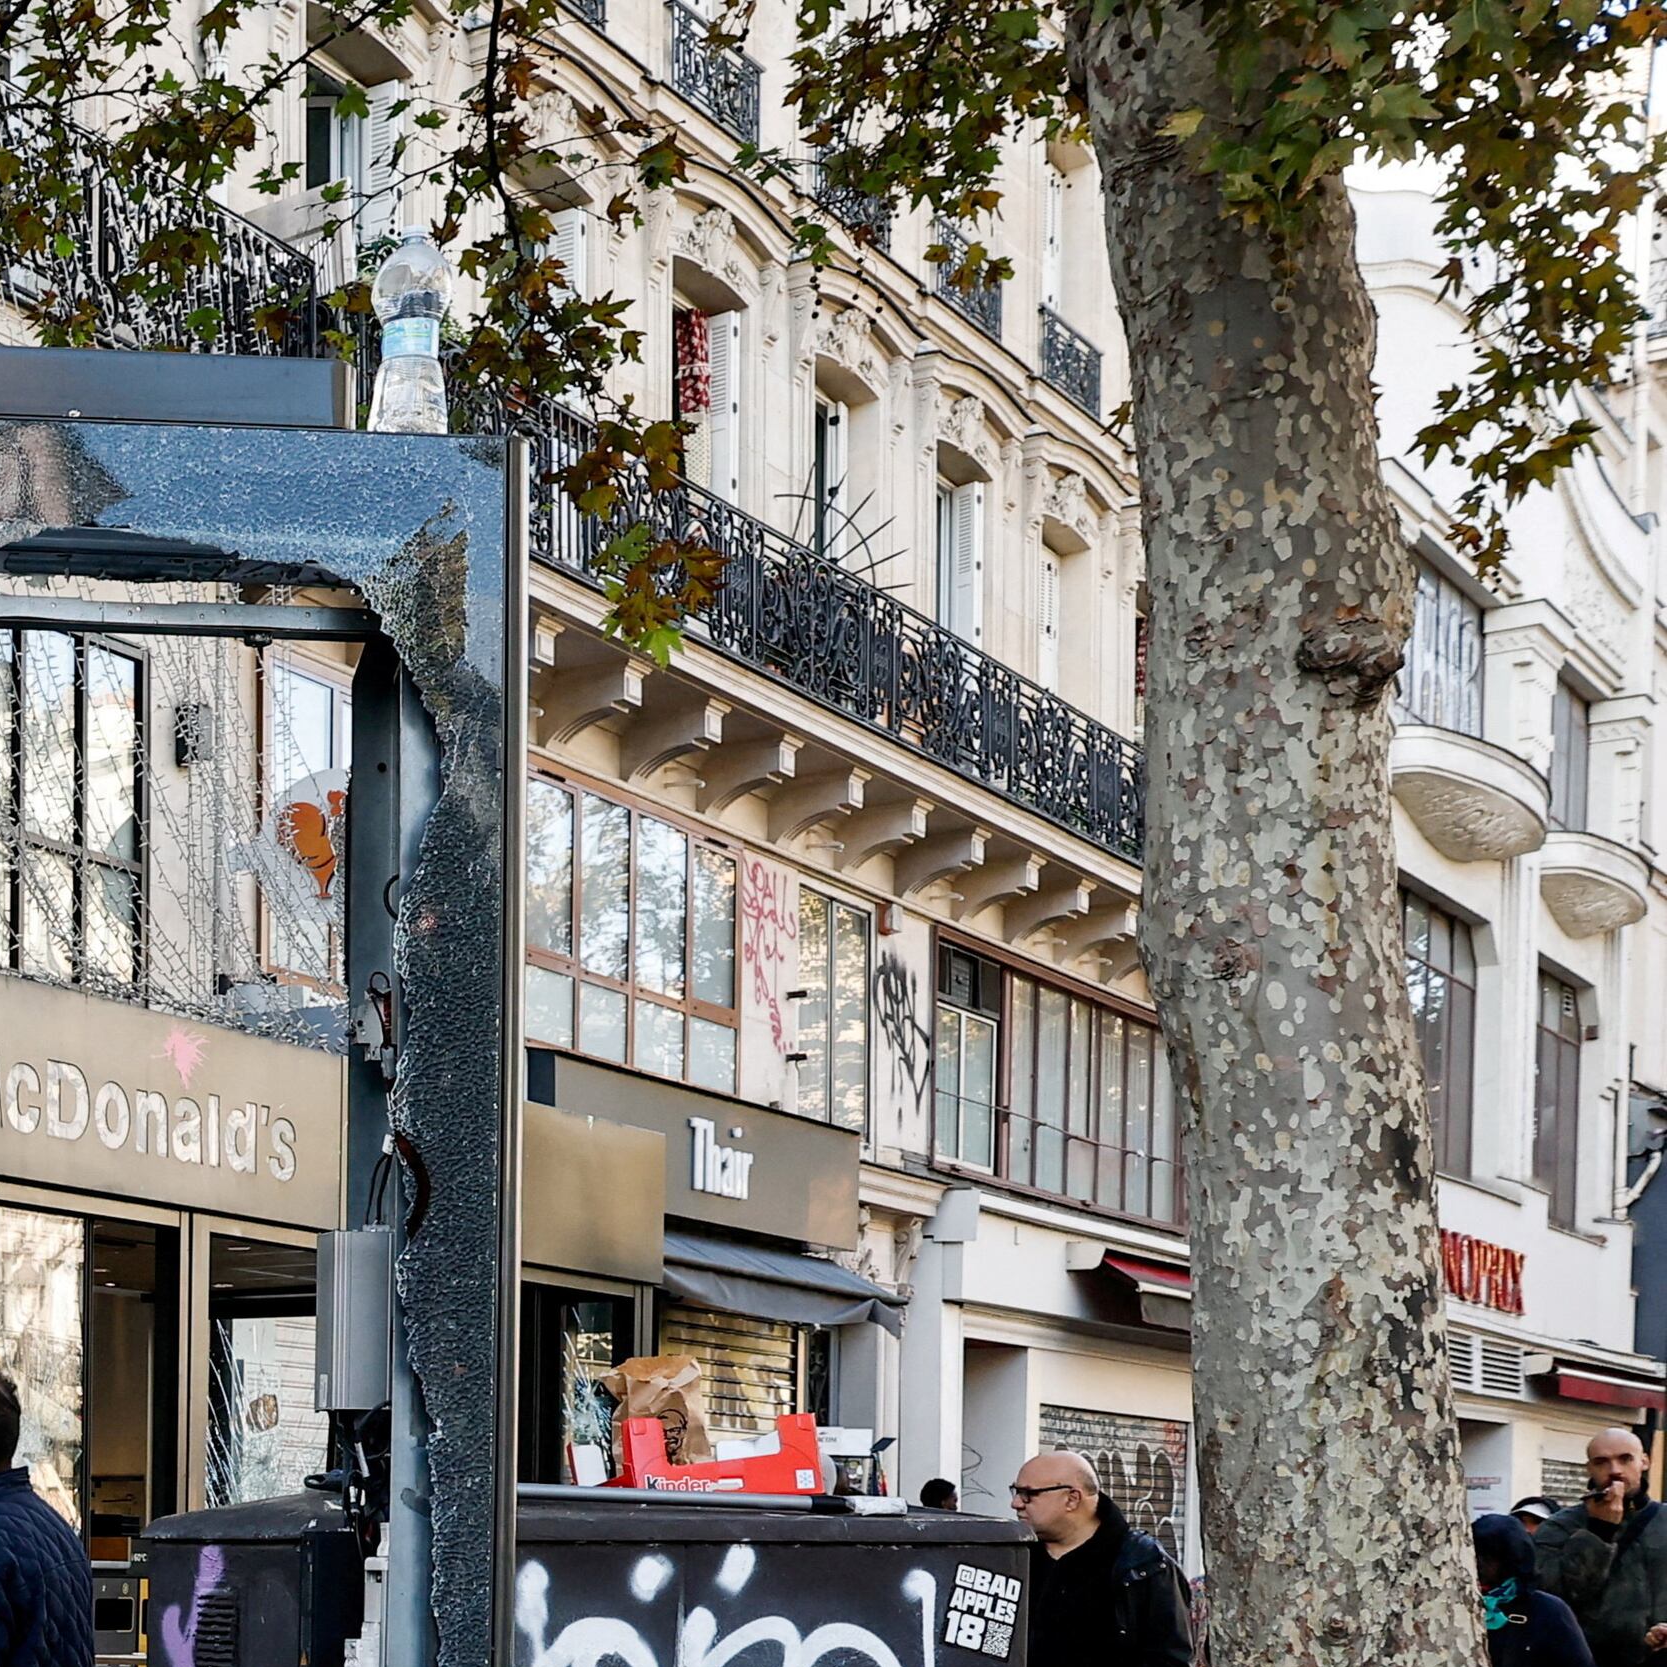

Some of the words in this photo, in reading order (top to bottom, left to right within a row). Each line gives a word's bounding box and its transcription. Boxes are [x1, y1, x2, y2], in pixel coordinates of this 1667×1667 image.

[955, 1564, 1022, 1603] @BAD
[949, 1586, 1017, 1625] APPLES
[945, 1609, 986, 1651] 18
